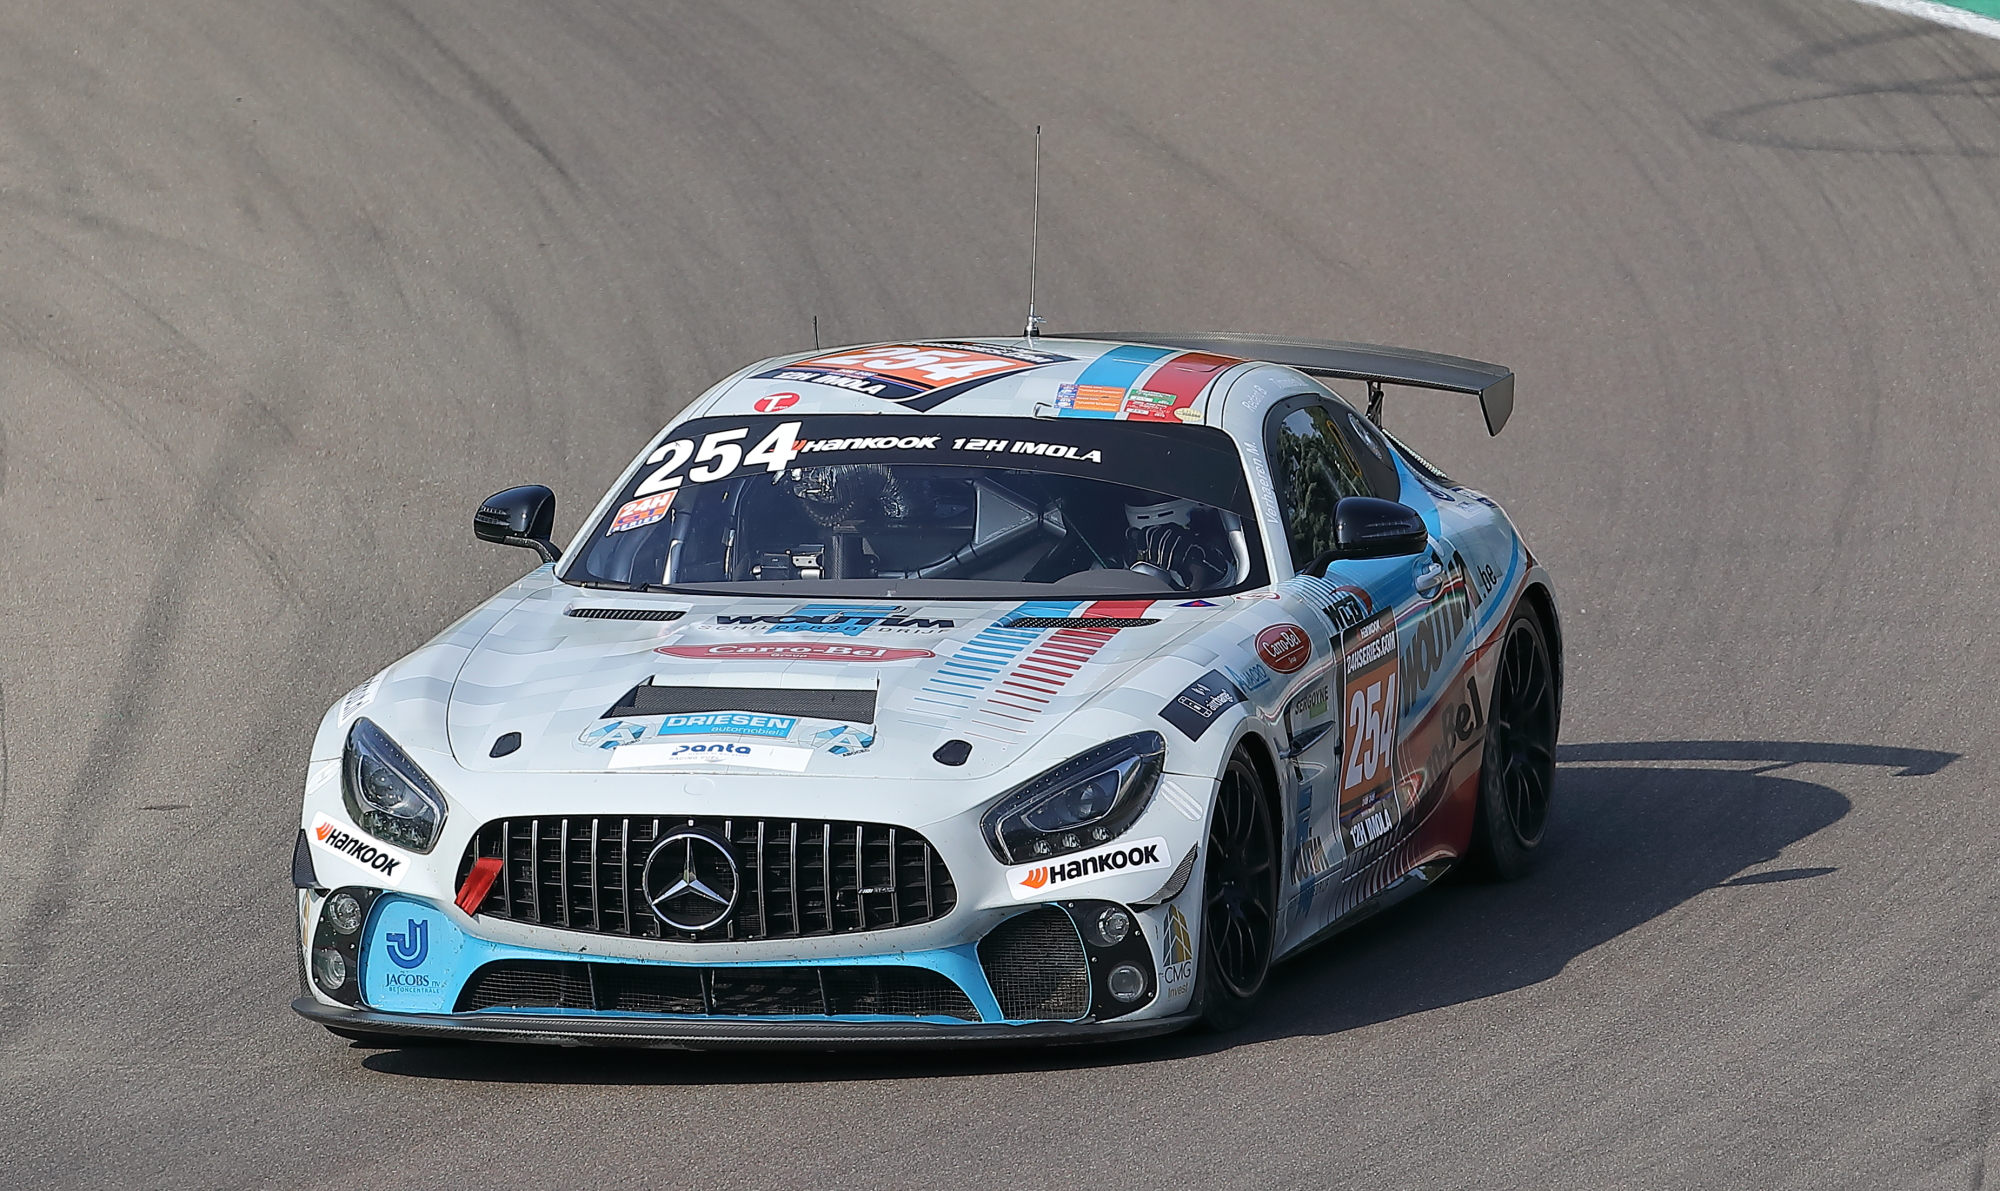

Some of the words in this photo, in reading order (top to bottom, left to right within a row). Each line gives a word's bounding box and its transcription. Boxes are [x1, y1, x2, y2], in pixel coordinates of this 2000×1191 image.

[808, 345, 1018, 381] 254
[811, 374, 887, 395] IMOLA
[633, 421, 802, 498] 254
[952, 438, 1005, 452] 12H
[1009, 441, 1102, 463] IMOLA
[620, 493, 672, 517] 24H
[708, 645, 887, 658] Carro-Bel
[1262, 628, 1302, 658] Carro-Bel
[1346, 631, 1396, 675] 24HSERIES.COM
[666, 714, 791, 729] DRIESEN
[1344, 672, 1397, 790] 254
[671, 743, 751, 756] panta
[1350, 821, 1368, 849] 12H
[1365, 808, 1393, 841] IMOLA
[385, 973, 430, 988] JACOBS
[1164, 961, 1192, 984] CMG
[1167, 983, 1189, 999] Invest
